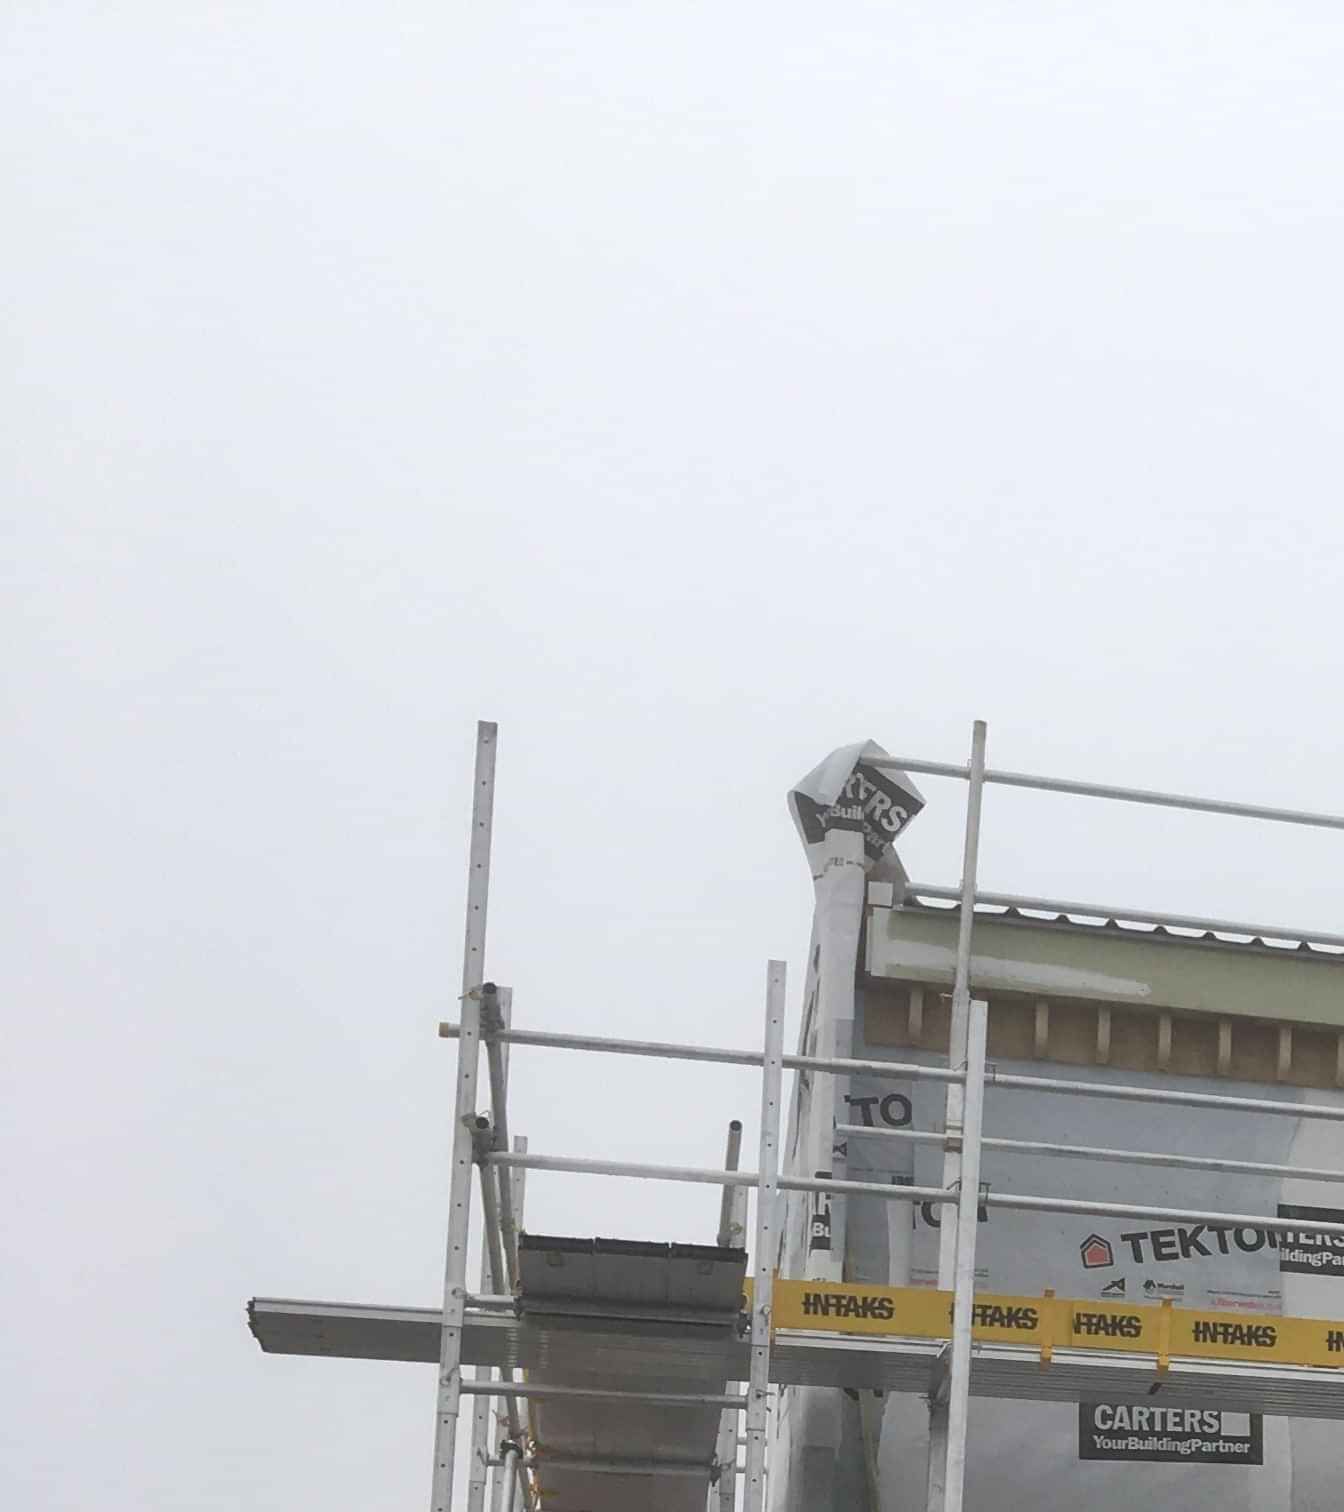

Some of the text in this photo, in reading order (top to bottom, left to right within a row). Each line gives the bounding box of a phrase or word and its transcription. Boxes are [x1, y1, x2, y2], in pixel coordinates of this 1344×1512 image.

[801, 1292, 894, 1320] INTAKS
[949, 1303, 1039, 1330] ITAKS
[1192, 1320, 1278, 1347] INTAKS
[1093, 1405, 1221, 1435] CARTERS
[1093, 1435, 1250, 1455] YourBuildingPartner
